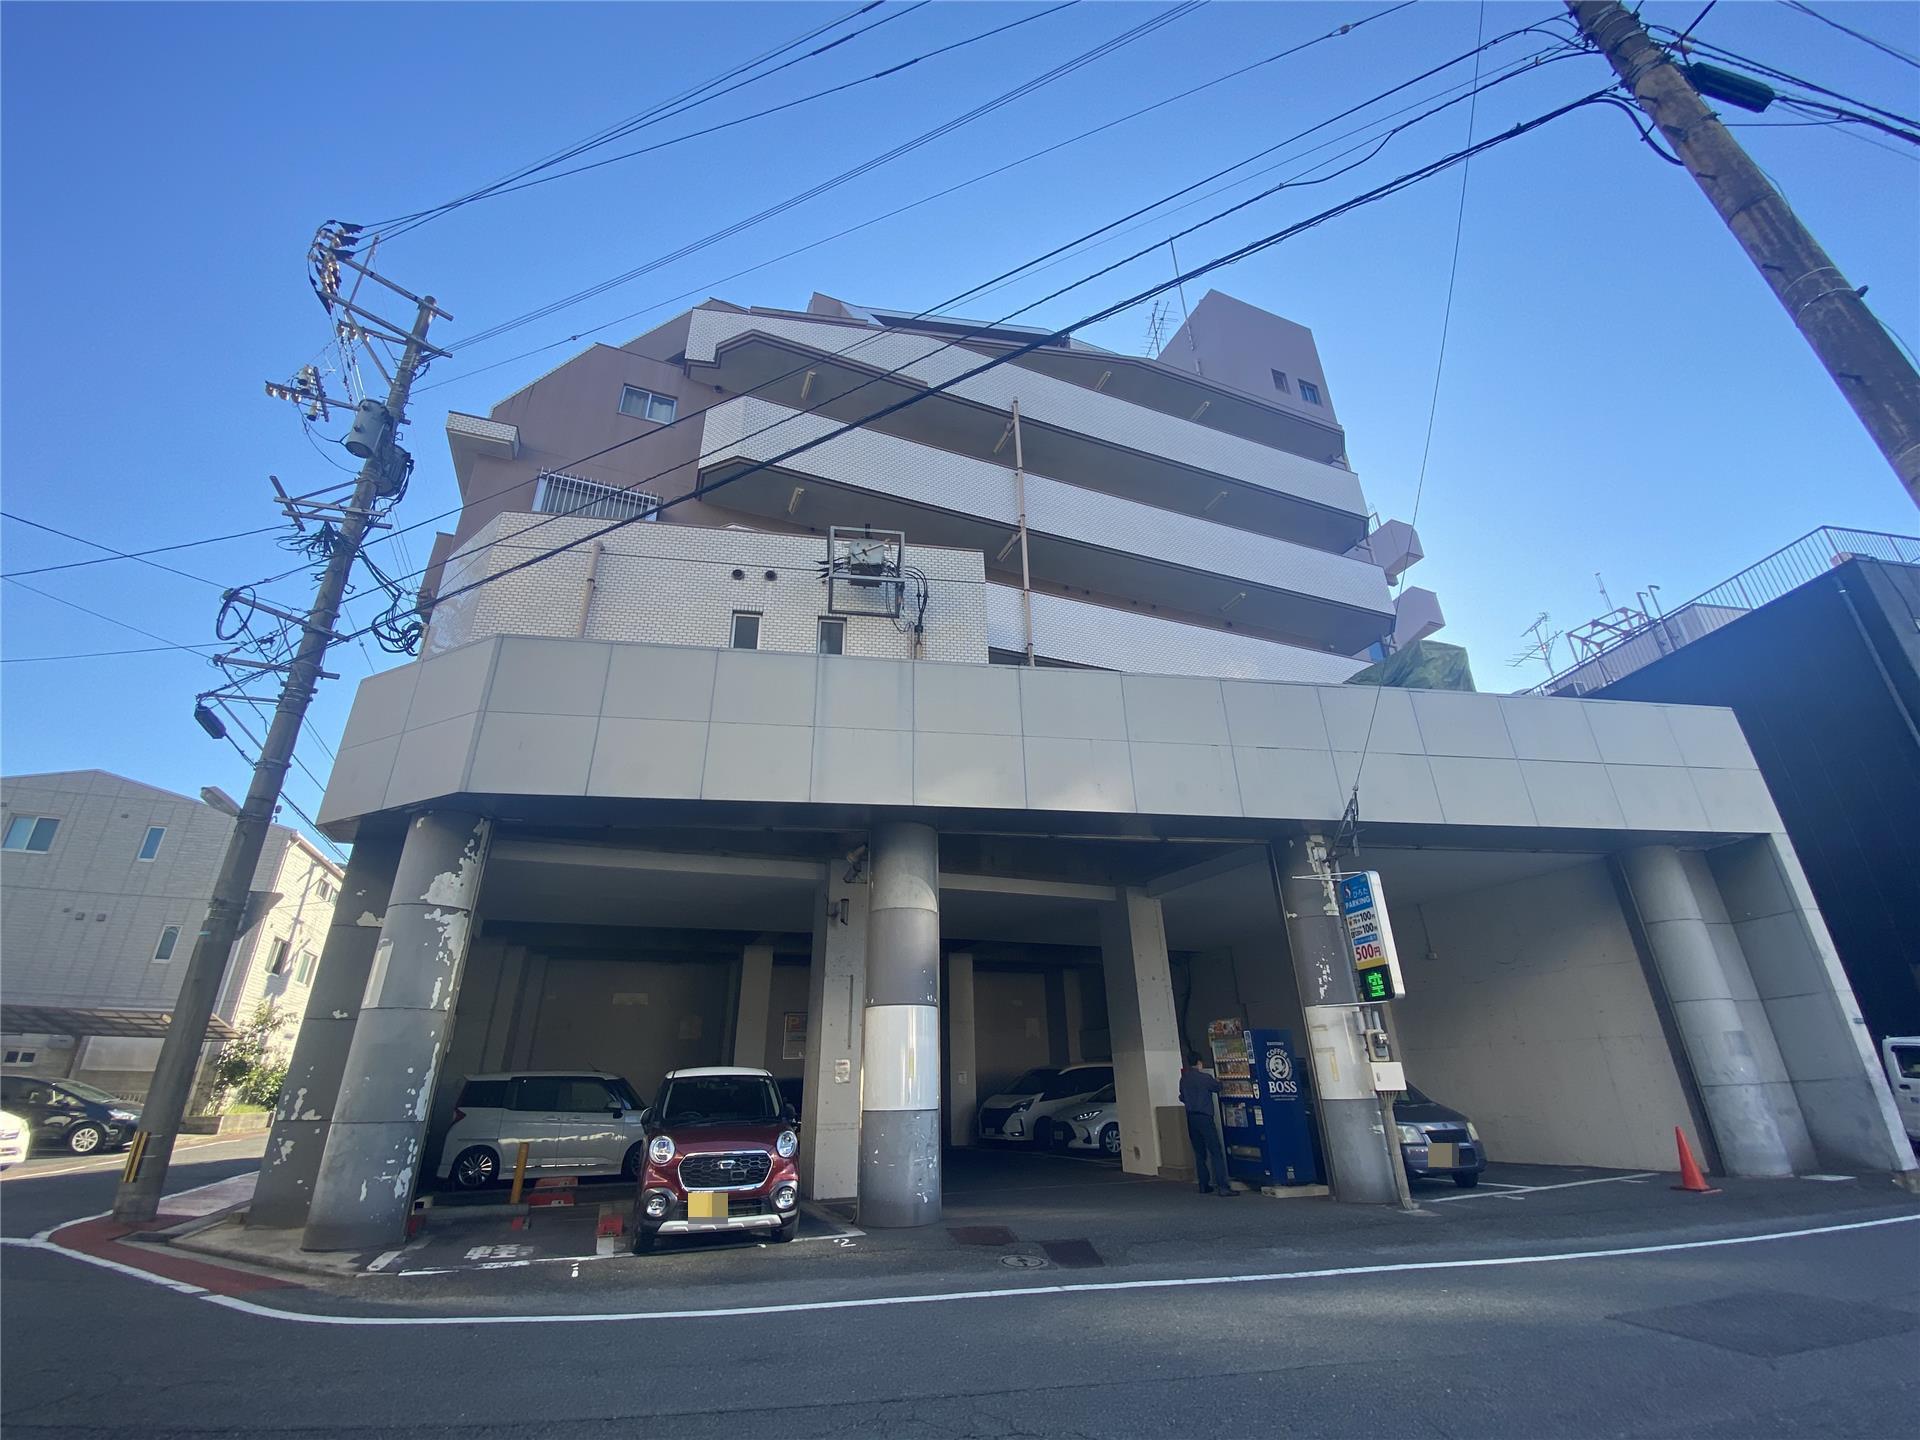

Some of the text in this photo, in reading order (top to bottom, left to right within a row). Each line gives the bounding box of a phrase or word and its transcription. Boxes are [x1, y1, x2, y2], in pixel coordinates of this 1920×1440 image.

[1345, 895, 1371, 910] PARKING
[1355, 944, 1381, 961] 500円
[1266, 1048, 1288, 1058] COFFEE
[1268, 1080, 1297, 1093] BOSS
